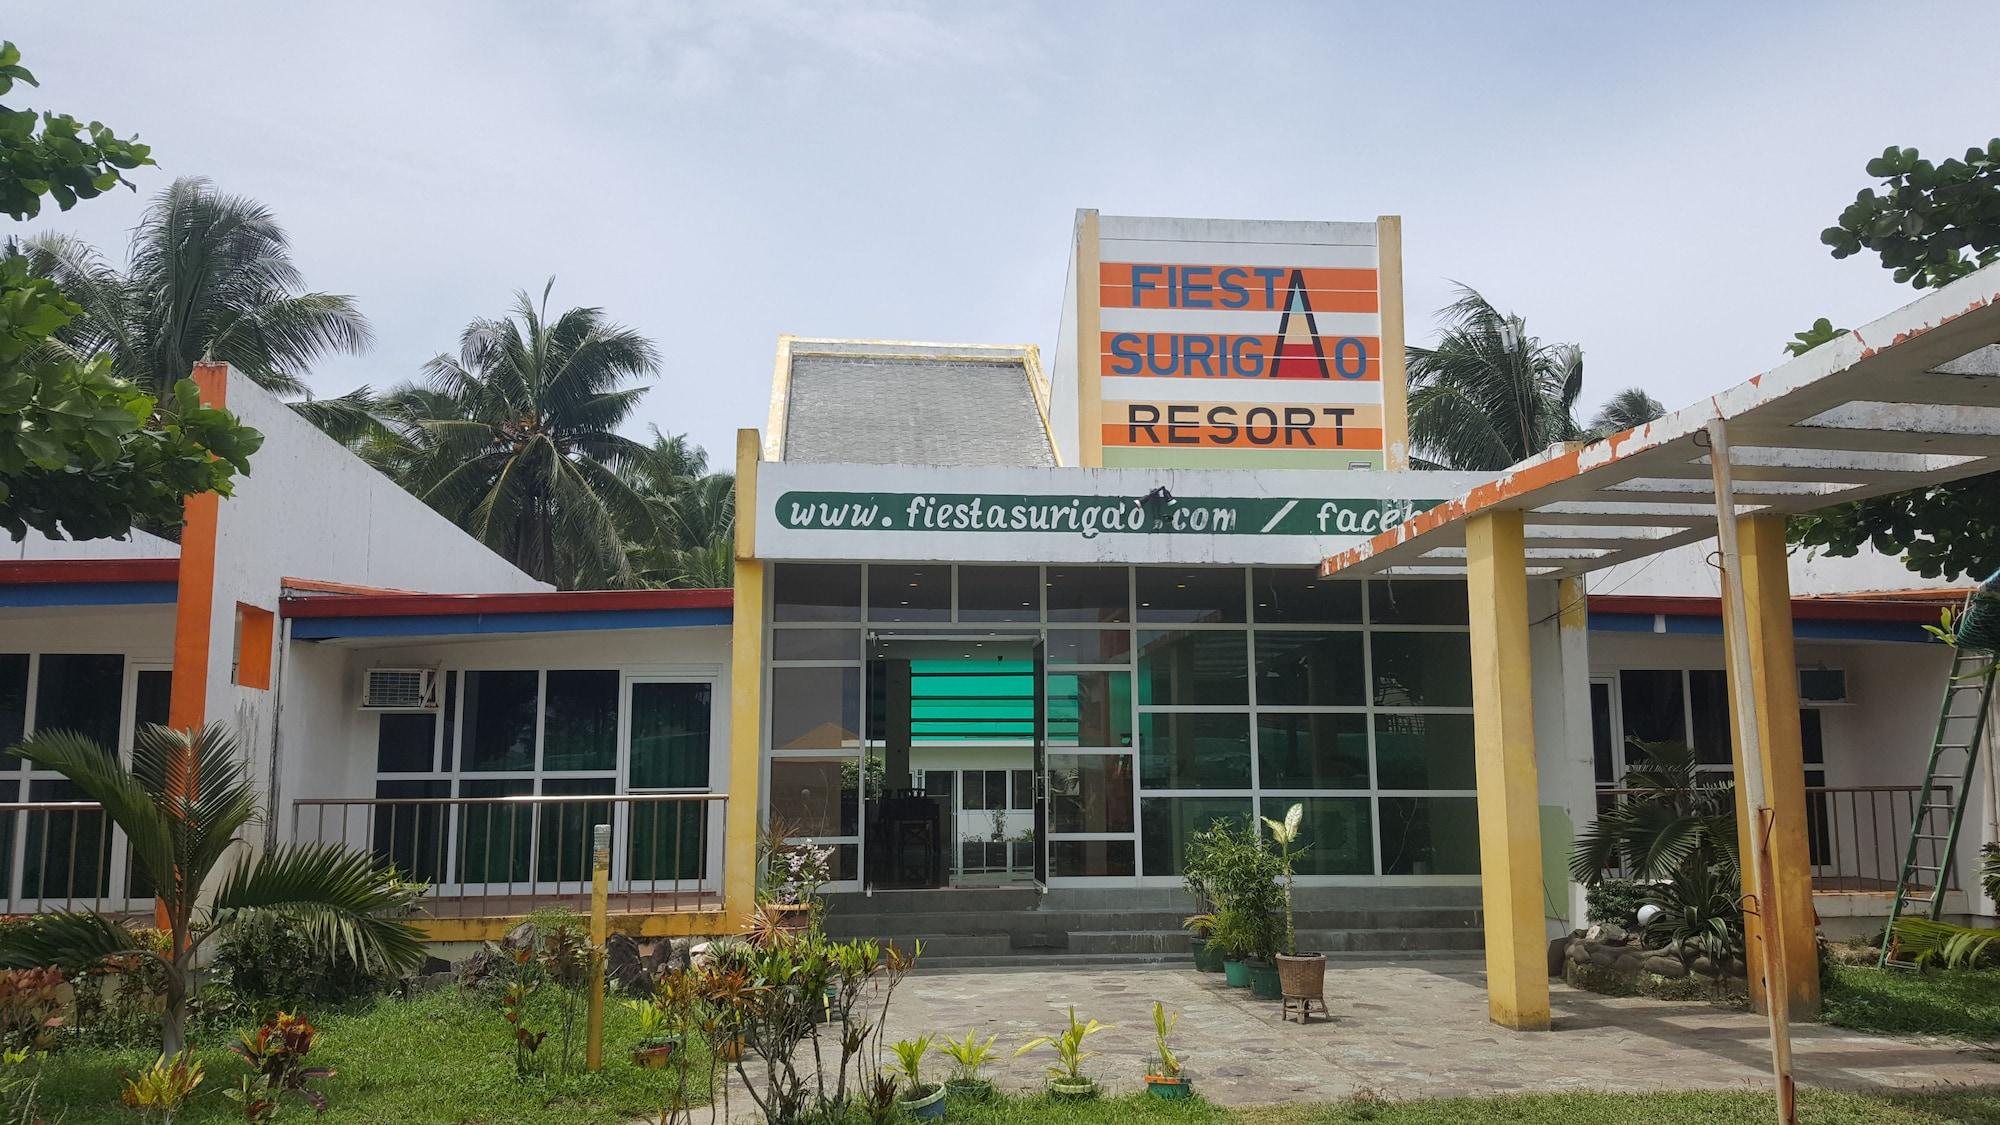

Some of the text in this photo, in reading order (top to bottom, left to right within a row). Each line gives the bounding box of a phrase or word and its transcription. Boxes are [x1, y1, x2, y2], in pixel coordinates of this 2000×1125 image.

[1131, 264, 1319, 310] FIESTA
[1110, 332, 1367, 379] SURIGAO
[1128, 404, 1355, 446] RESORT
